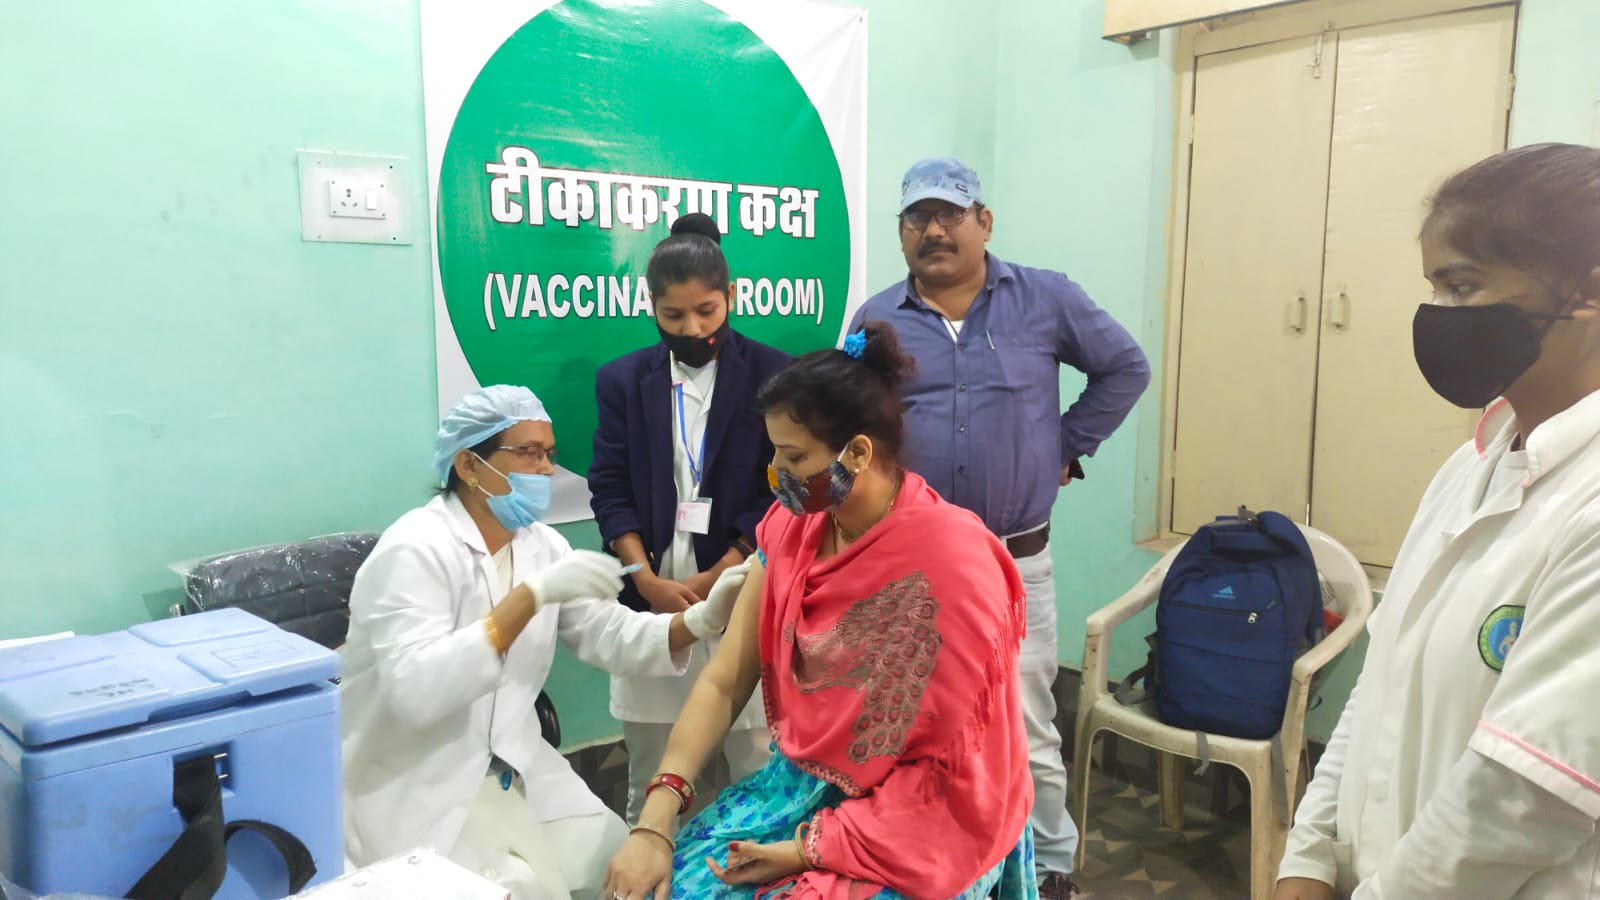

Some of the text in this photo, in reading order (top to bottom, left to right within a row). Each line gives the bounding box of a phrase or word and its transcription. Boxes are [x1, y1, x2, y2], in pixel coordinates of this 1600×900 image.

[485, 146, 819, 238] टीकाकरण कक्ष
[484, 272, 824, 331] (VACCINA ROOM)
